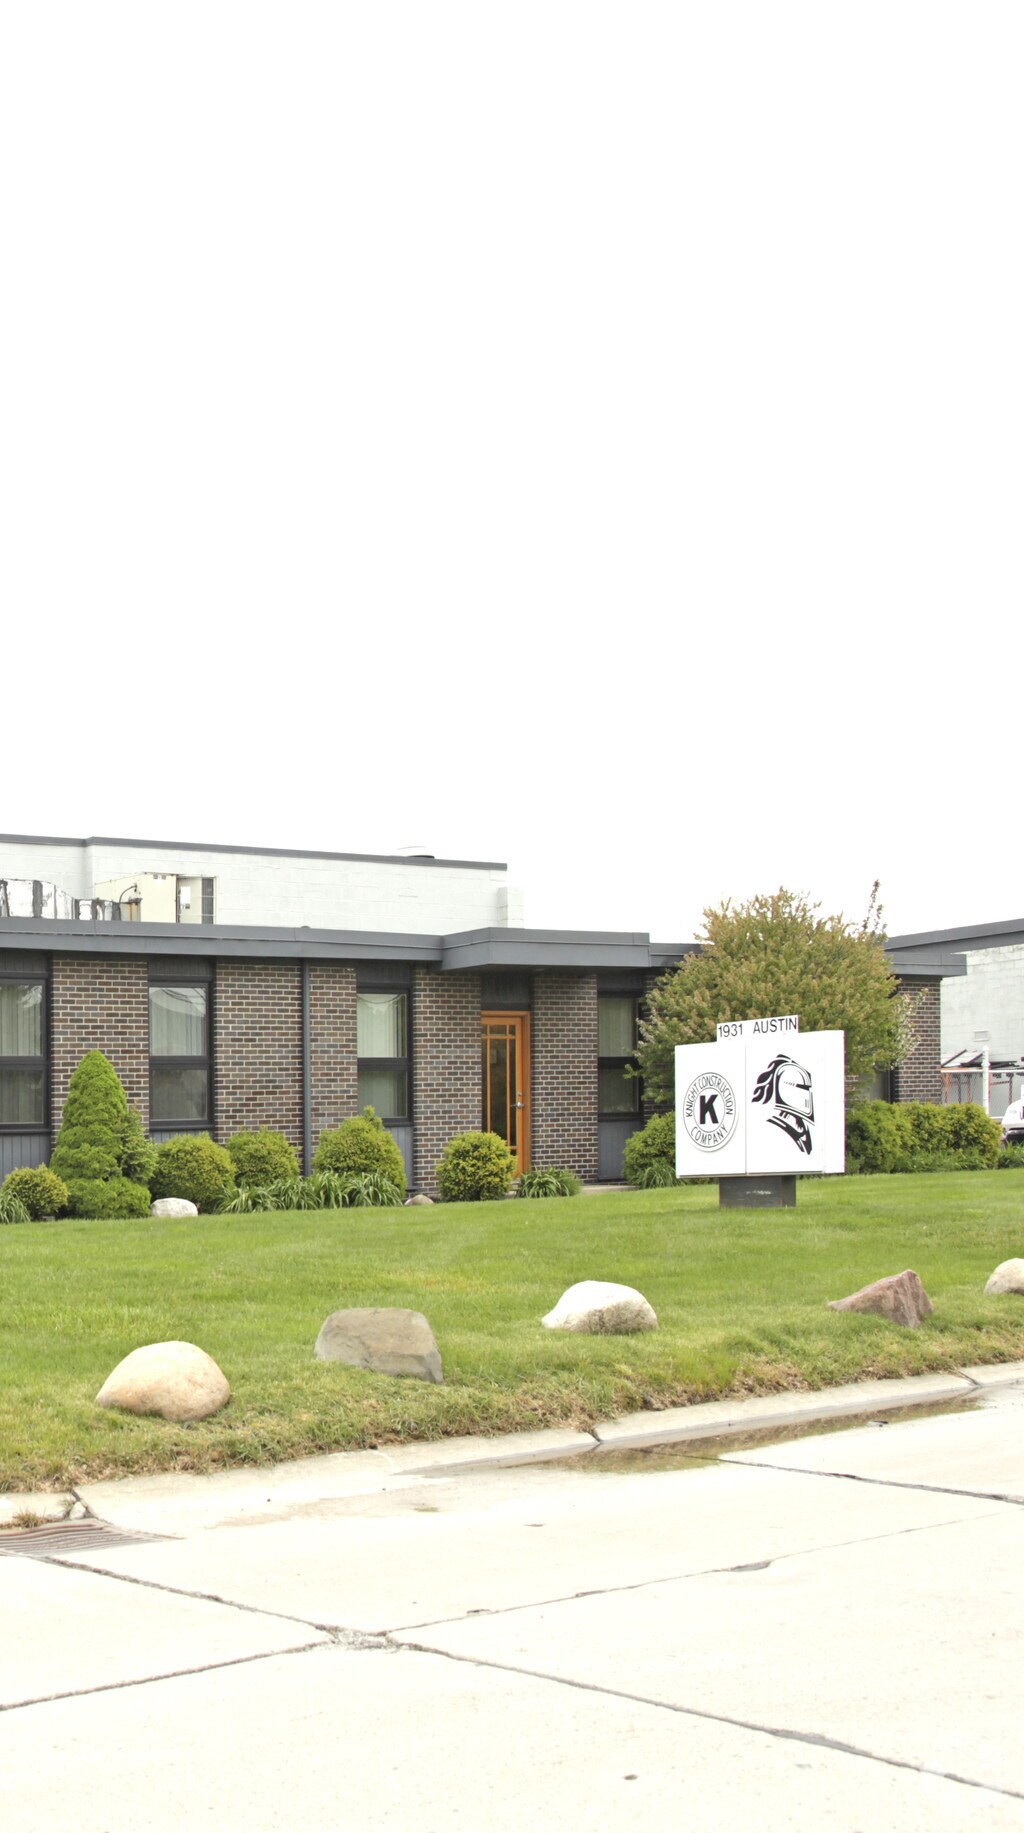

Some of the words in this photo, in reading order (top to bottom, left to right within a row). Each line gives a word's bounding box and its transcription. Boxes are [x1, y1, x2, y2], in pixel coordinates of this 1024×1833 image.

[718, 1023, 743, 1038] 1931
[753, 1017, 797, 1035] AUSTIN
[685, 1082, 700, 1118] KNIGHT
[698, 1075, 733, 1115] CONSTRUCTION
[699, 1094, 719, 1125] K
[690, 1124, 728, 1145] COMPANY
